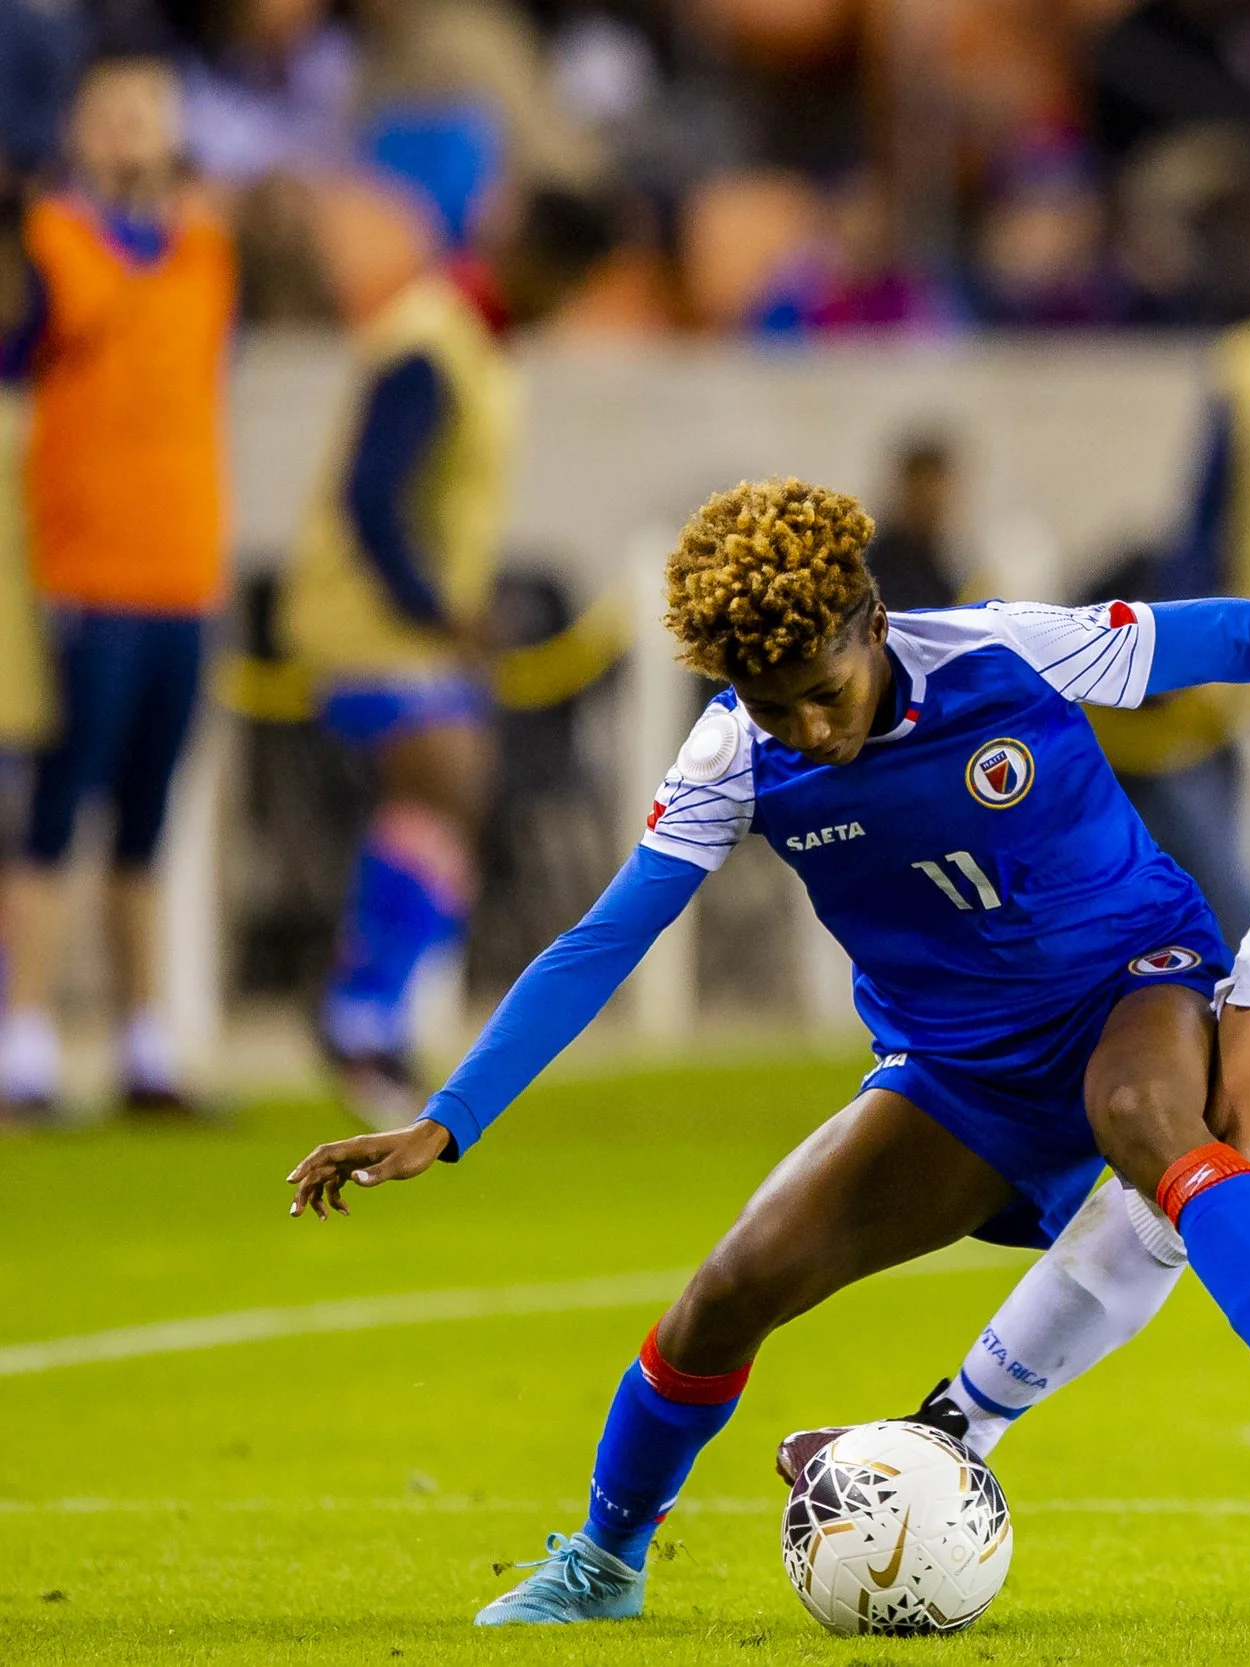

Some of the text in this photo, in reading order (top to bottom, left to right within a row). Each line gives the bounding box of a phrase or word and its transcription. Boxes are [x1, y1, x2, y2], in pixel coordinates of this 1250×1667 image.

[983, 753, 1005, 769] HAITI
[786, 821, 866, 851] SAETA
[912, 851, 1002, 911] 11
[1006, 1361, 1048, 1390] RICA
